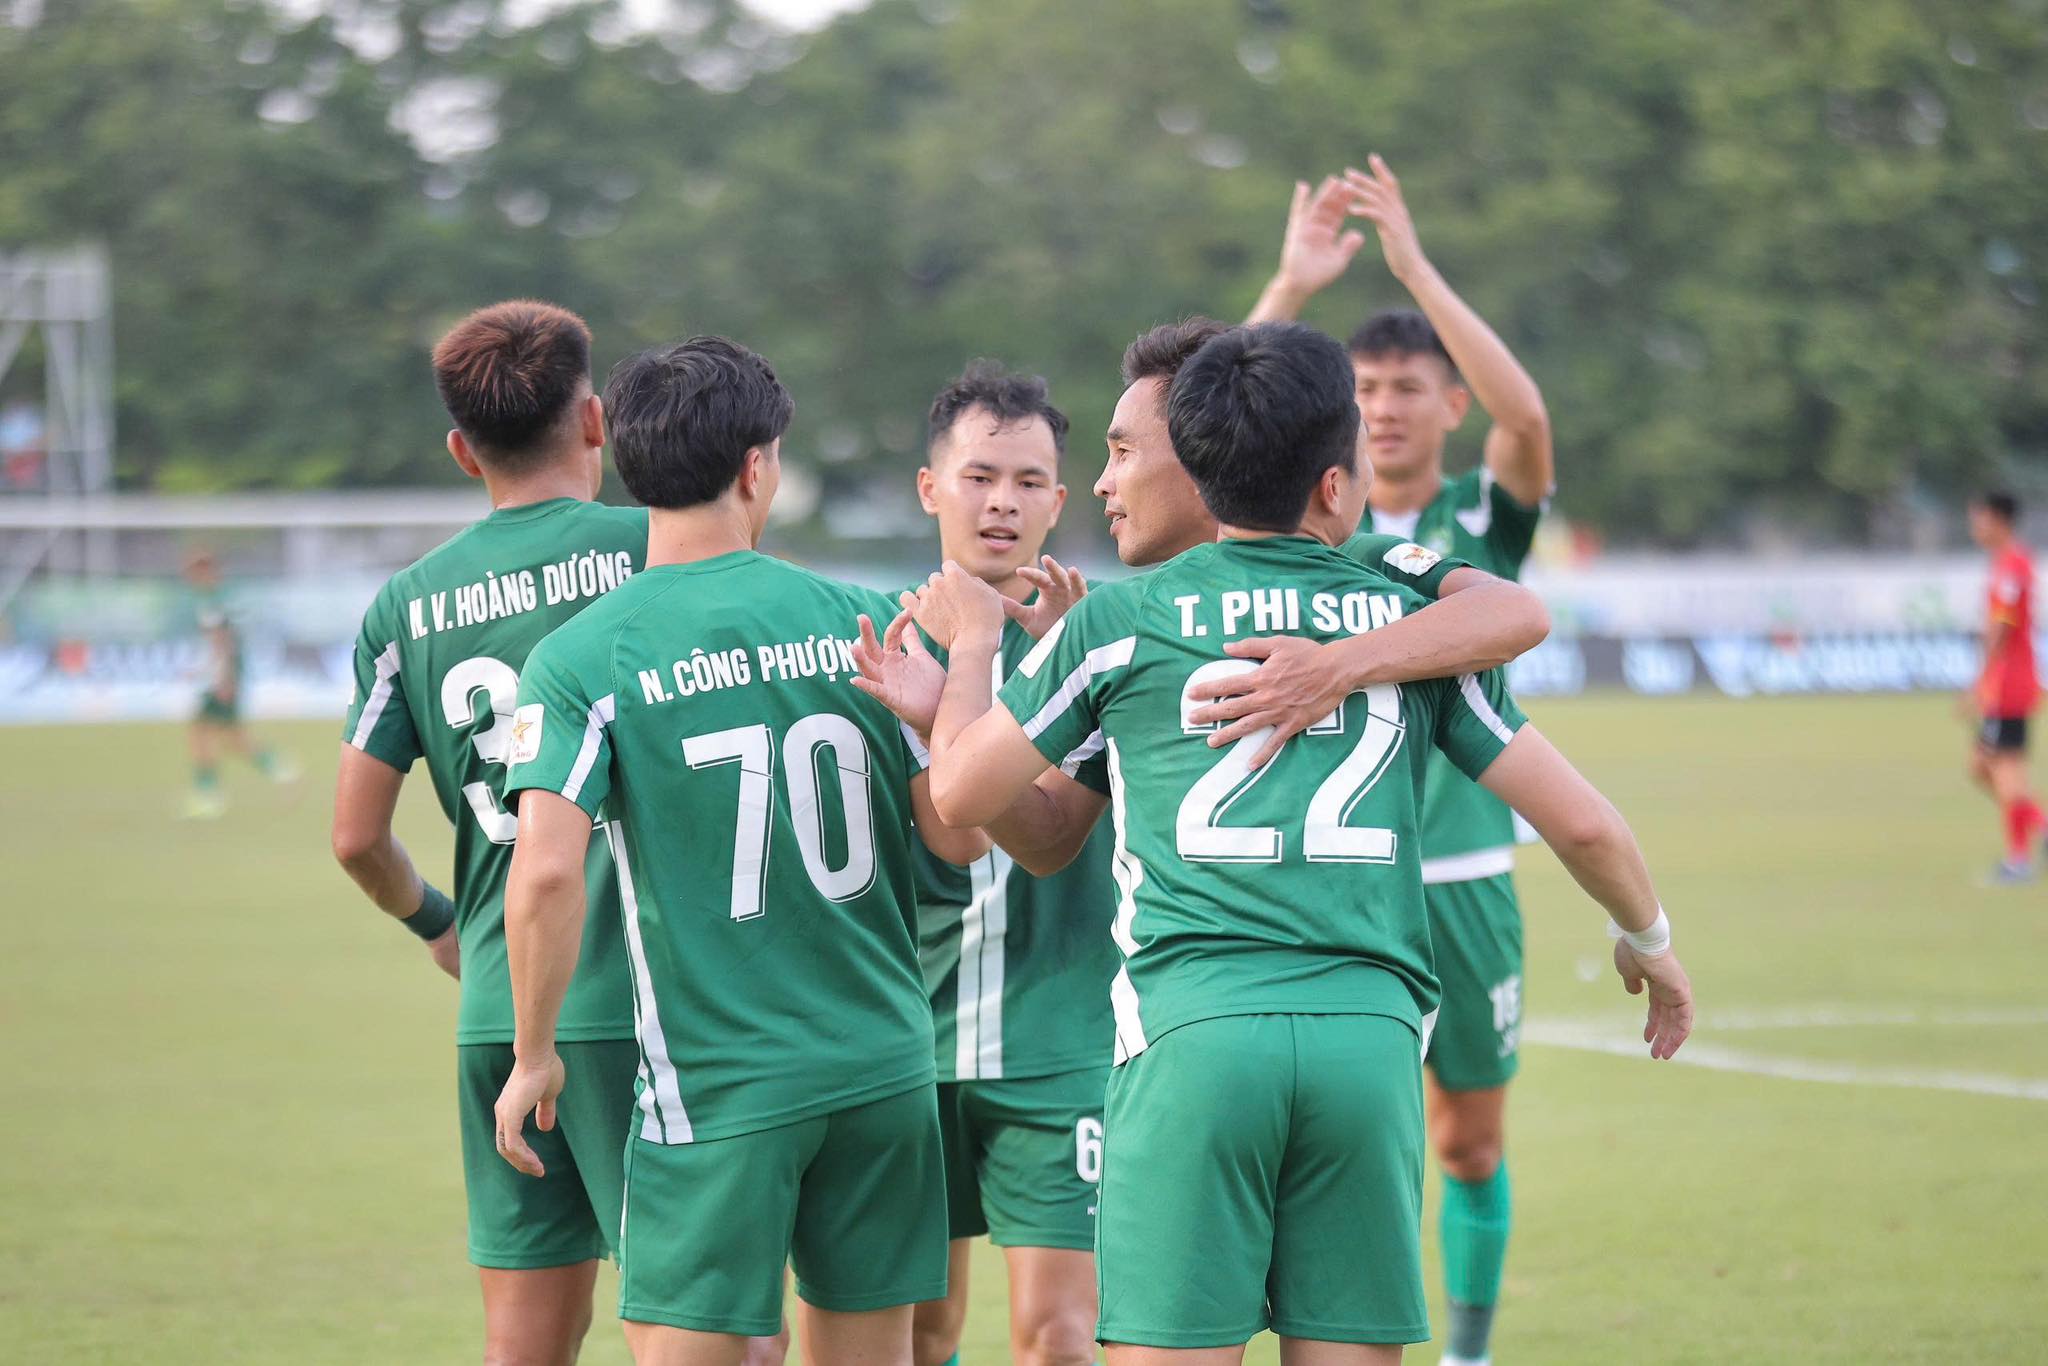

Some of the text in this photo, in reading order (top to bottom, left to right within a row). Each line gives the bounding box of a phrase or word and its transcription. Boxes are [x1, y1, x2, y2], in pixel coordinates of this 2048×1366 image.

[542, 549, 633, 606] DƯƠNG
[1174, 588, 1404, 638] T. PHI SƠN
[638, 634, 862, 705] N. CÔNG PHƯỢN
[1176, 659, 1407, 865] 22
[681, 713, 878, 922] 70
[1076, 1117, 1103, 1183] 6
